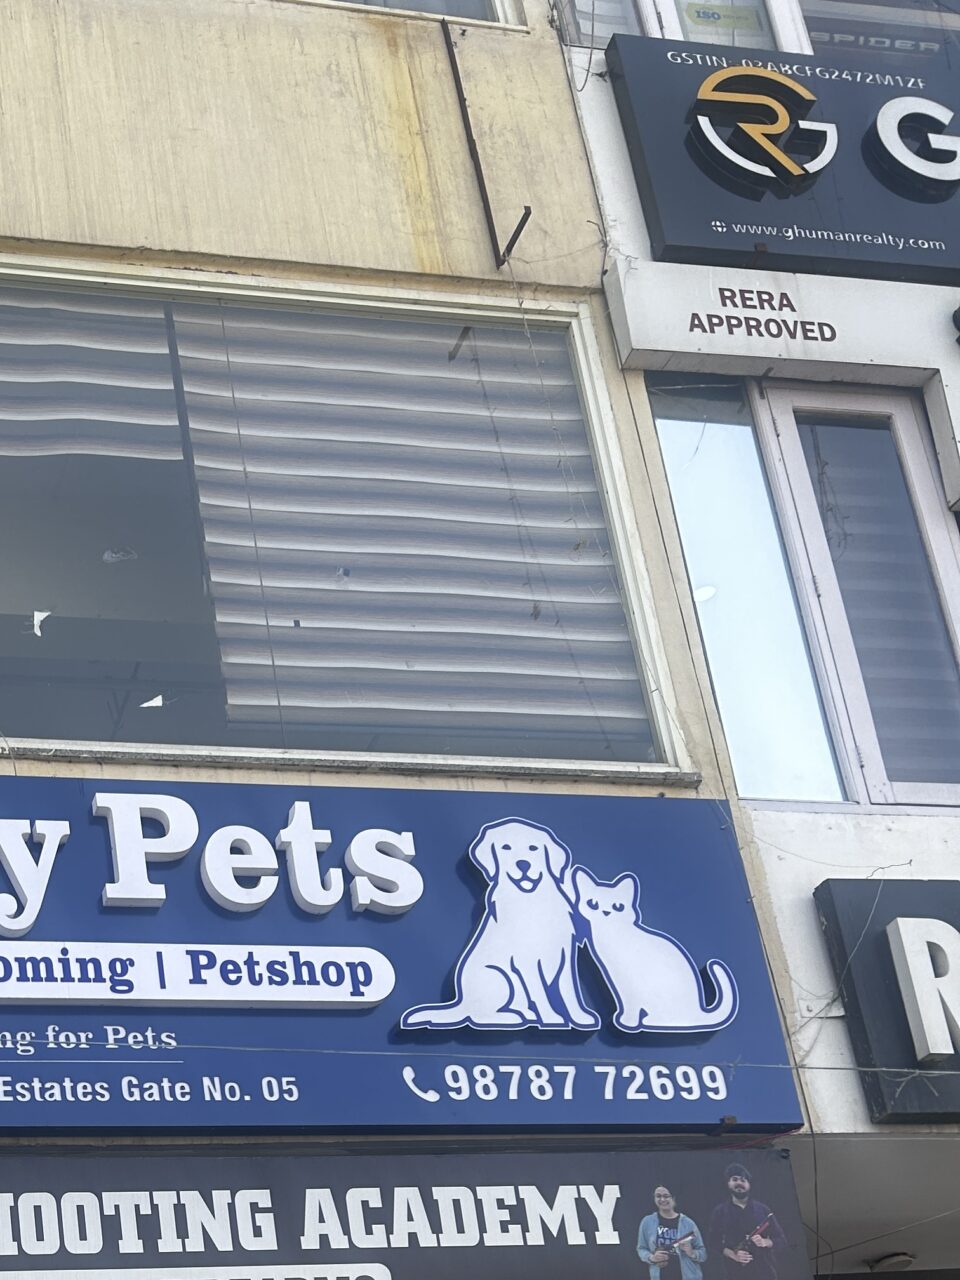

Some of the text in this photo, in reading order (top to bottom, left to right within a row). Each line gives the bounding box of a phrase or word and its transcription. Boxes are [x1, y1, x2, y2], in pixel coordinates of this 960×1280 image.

[695, 10, 721, 21] ISO
[809, 32, 940, 52] SPIDER
[731, 223, 947, 250] www.ghumanrealty.com
[718, 287, 797, 313] RERA
[688, 313, 837, 343] APPROVED
[91, 792, 425, 916] Pets
[185, 949, 374, 997] Petshop
[46, 1024, 94, 1050] for
[103, 1025, 178, 1050] Pets
[121, 1076, 192, 1103] Gate
[202, 1076, 252, 1103] No.
[261, 1076, 300, 1103] 05
[443, 1064, 728, 1101] 98787 72699
[300, 1184, 622, 1250] ACADEMY
